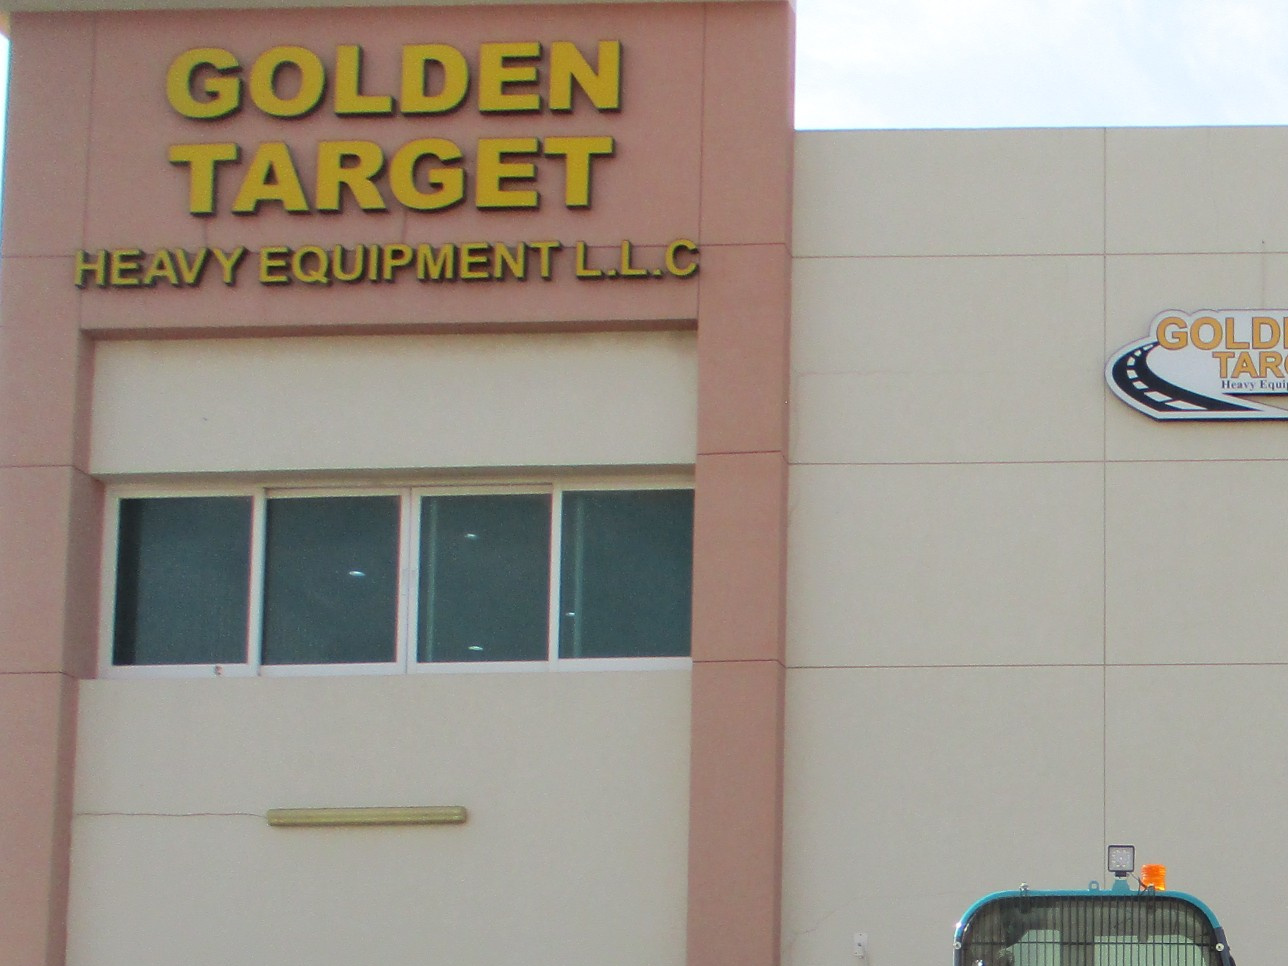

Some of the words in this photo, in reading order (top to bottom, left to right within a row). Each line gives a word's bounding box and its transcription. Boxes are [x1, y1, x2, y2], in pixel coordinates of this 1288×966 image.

[164, 40, 624, 120] GOLDEN
[168, 136, 614, 216] TARGET
[73, 248, 246, 288] HEAVY
[257, 241, 563, 287] EQUIPMENT
[574, 238, 699, 279] L.L.C
[1221, 380, 1256, 391] Heavy
